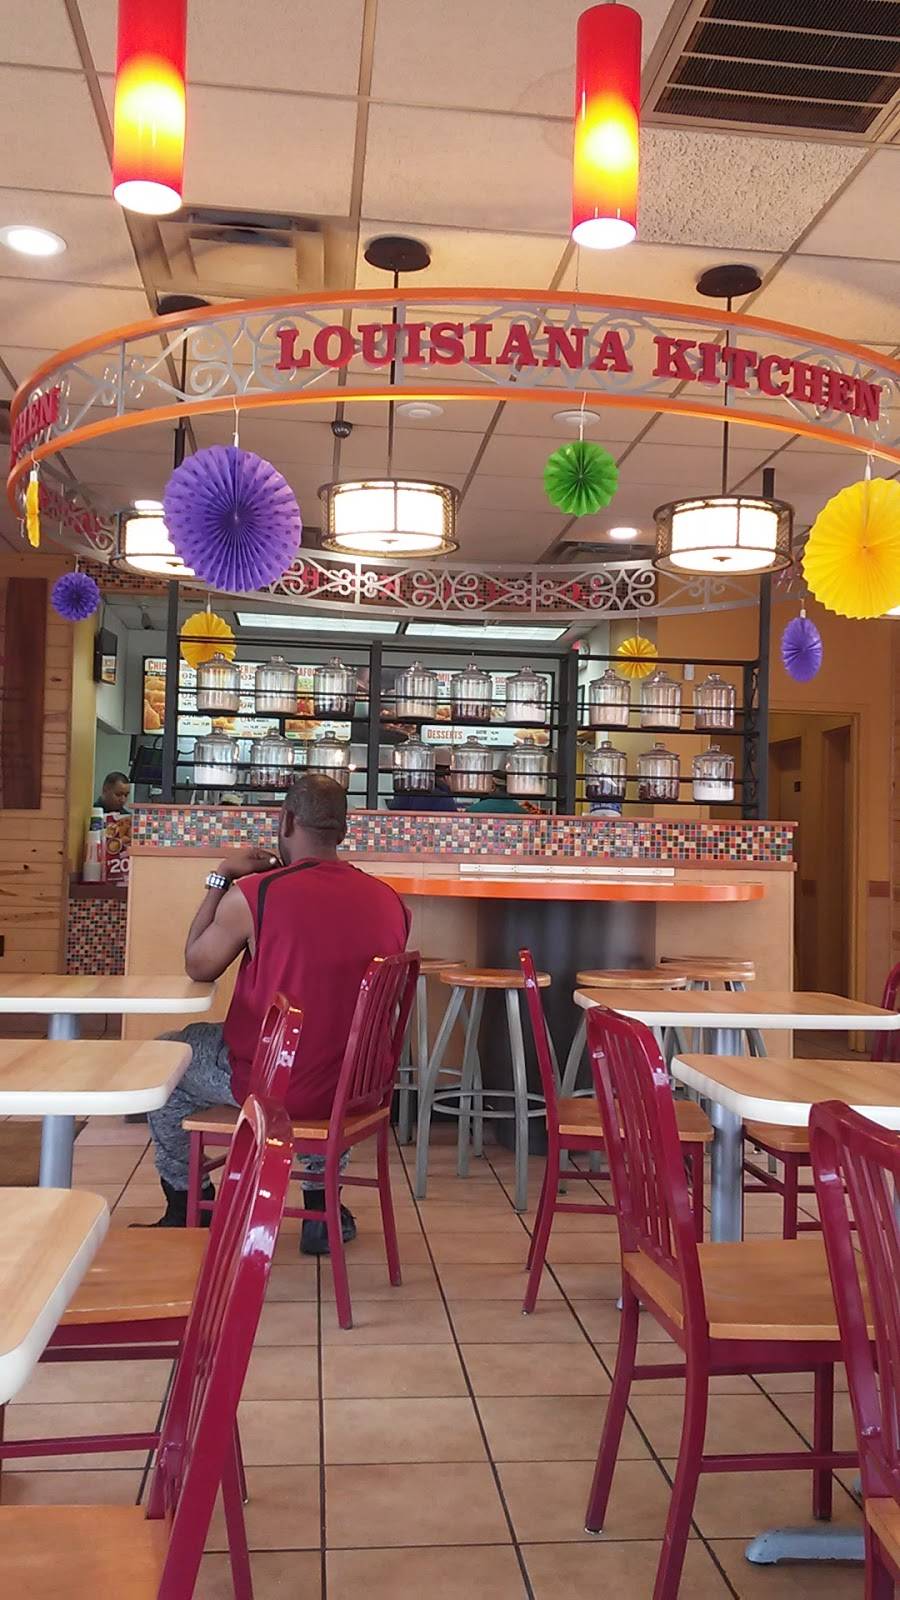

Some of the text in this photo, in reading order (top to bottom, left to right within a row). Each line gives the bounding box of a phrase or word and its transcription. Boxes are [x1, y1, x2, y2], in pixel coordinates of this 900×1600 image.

[275, 323, 882, 421] LOUISIANA KITCHEN
[427, 729, 463, 740] DESSERTS
